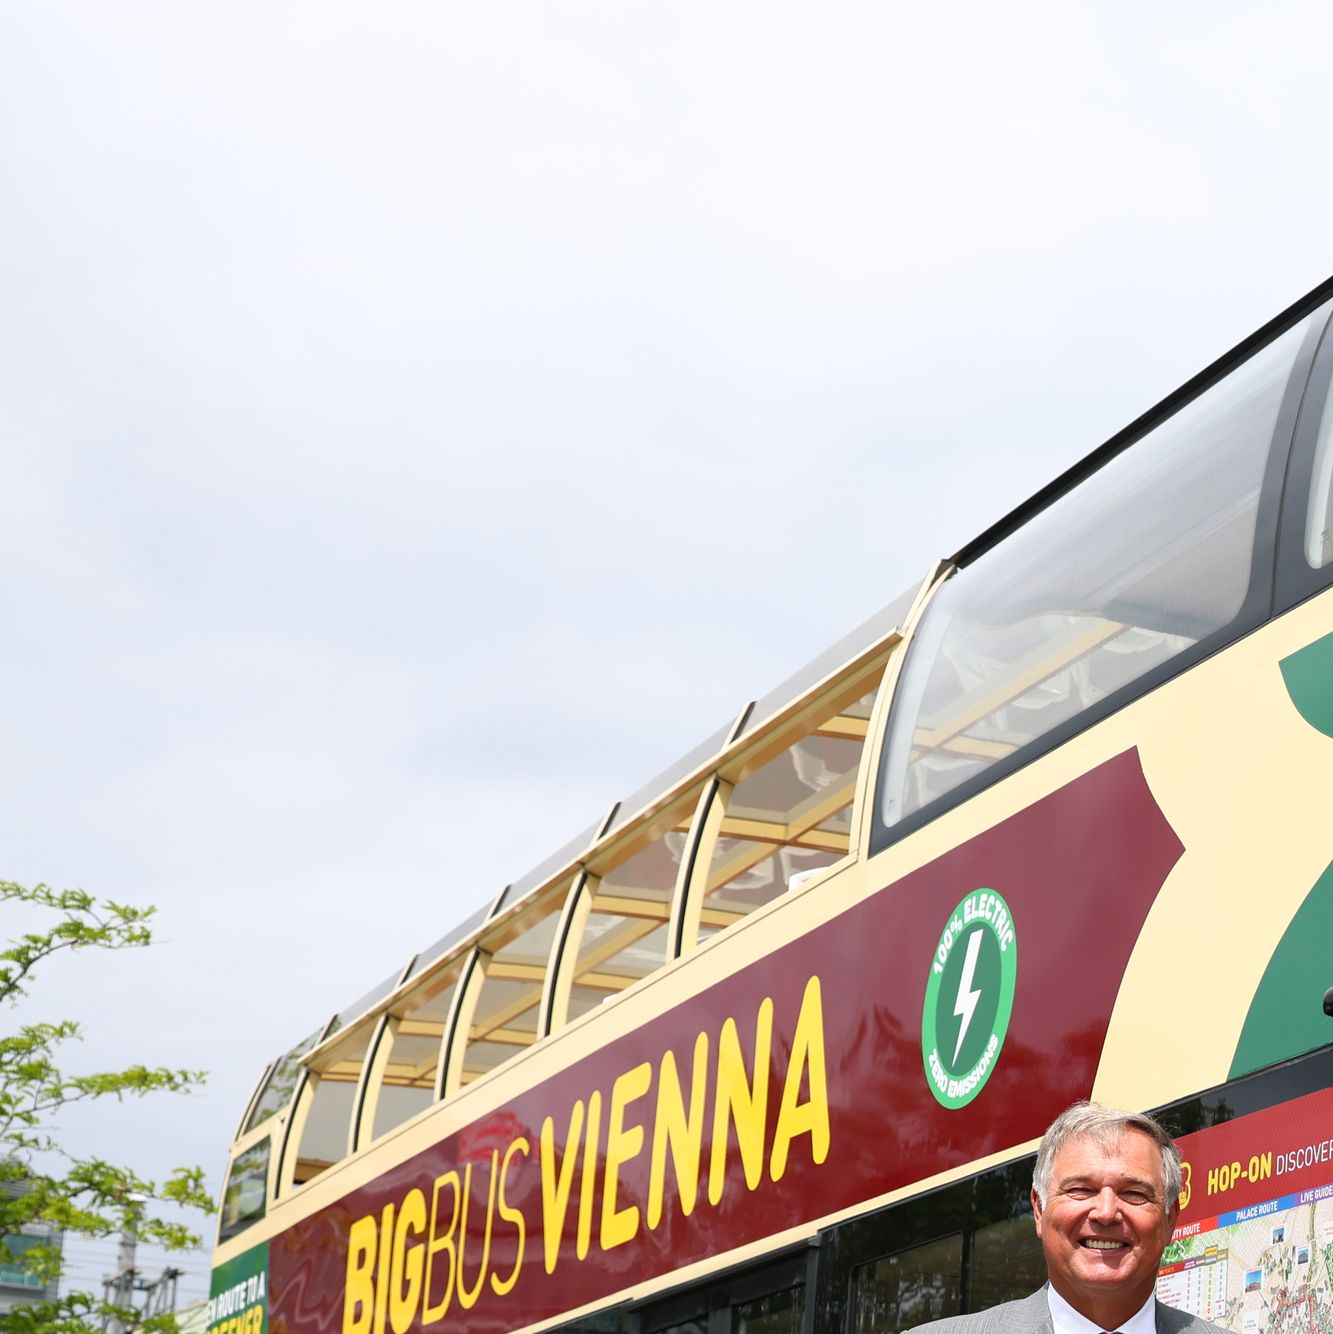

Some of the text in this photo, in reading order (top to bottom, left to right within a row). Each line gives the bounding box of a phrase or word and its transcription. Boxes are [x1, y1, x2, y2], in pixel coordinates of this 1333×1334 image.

[933, 893, 1014, 975] 100% ELECTRIC
[928, 1033, 999, 1098] ZERO EMISSIONS
[1207, 1151, 1272, 1196] HOP-ON
[1236, 1201, 1278, 1221] PALACE ROUTE
[1300, 1191, 1314, 1204] LIVE
[1182, 1223, 1201, 1236] ROUTE
[217, 1281, 248, 1321] ROUTE
[247, 1274, 258, 1306] TO
[257, 1270, 266, 1300] A
